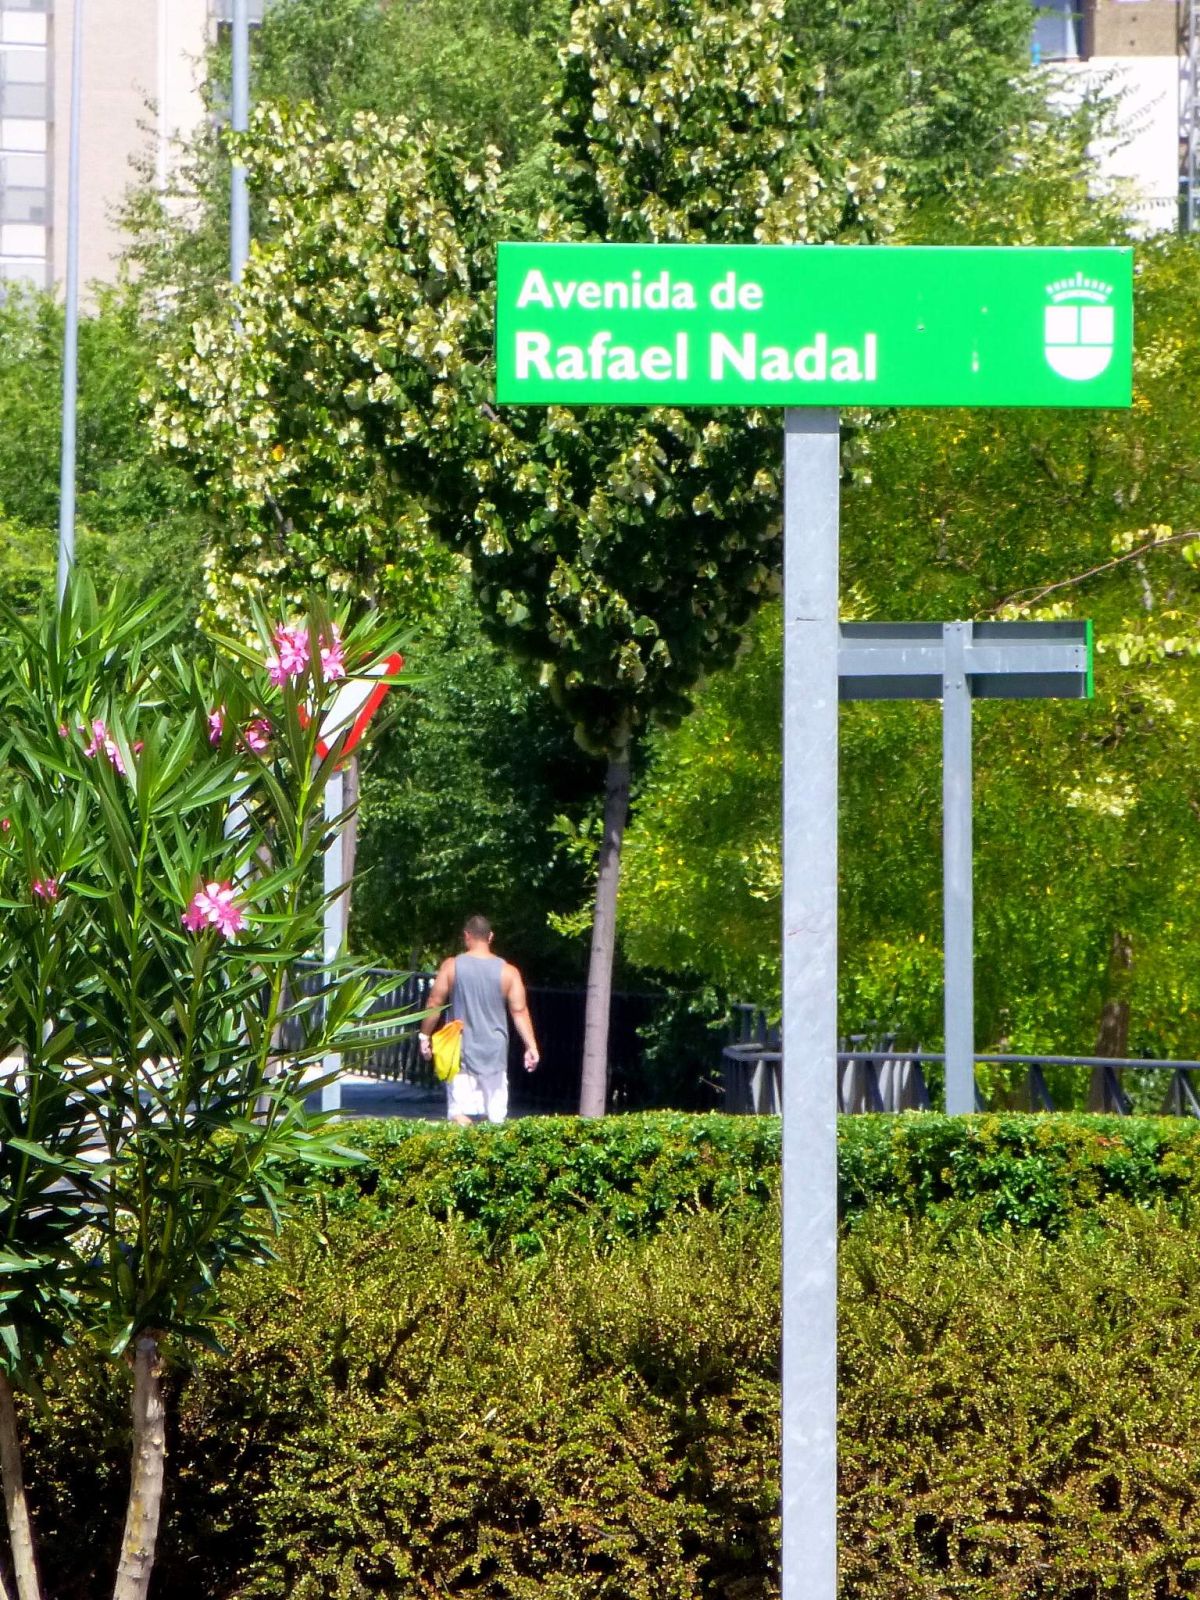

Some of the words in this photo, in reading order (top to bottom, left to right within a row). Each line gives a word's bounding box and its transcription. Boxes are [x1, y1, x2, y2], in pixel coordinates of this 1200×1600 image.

[515, 269, 698, 310] Avenida
[709, 270, 764, 311] de
[514, 331, 689, 381] Rafael
[709, 332, 877, 382] Nadal
